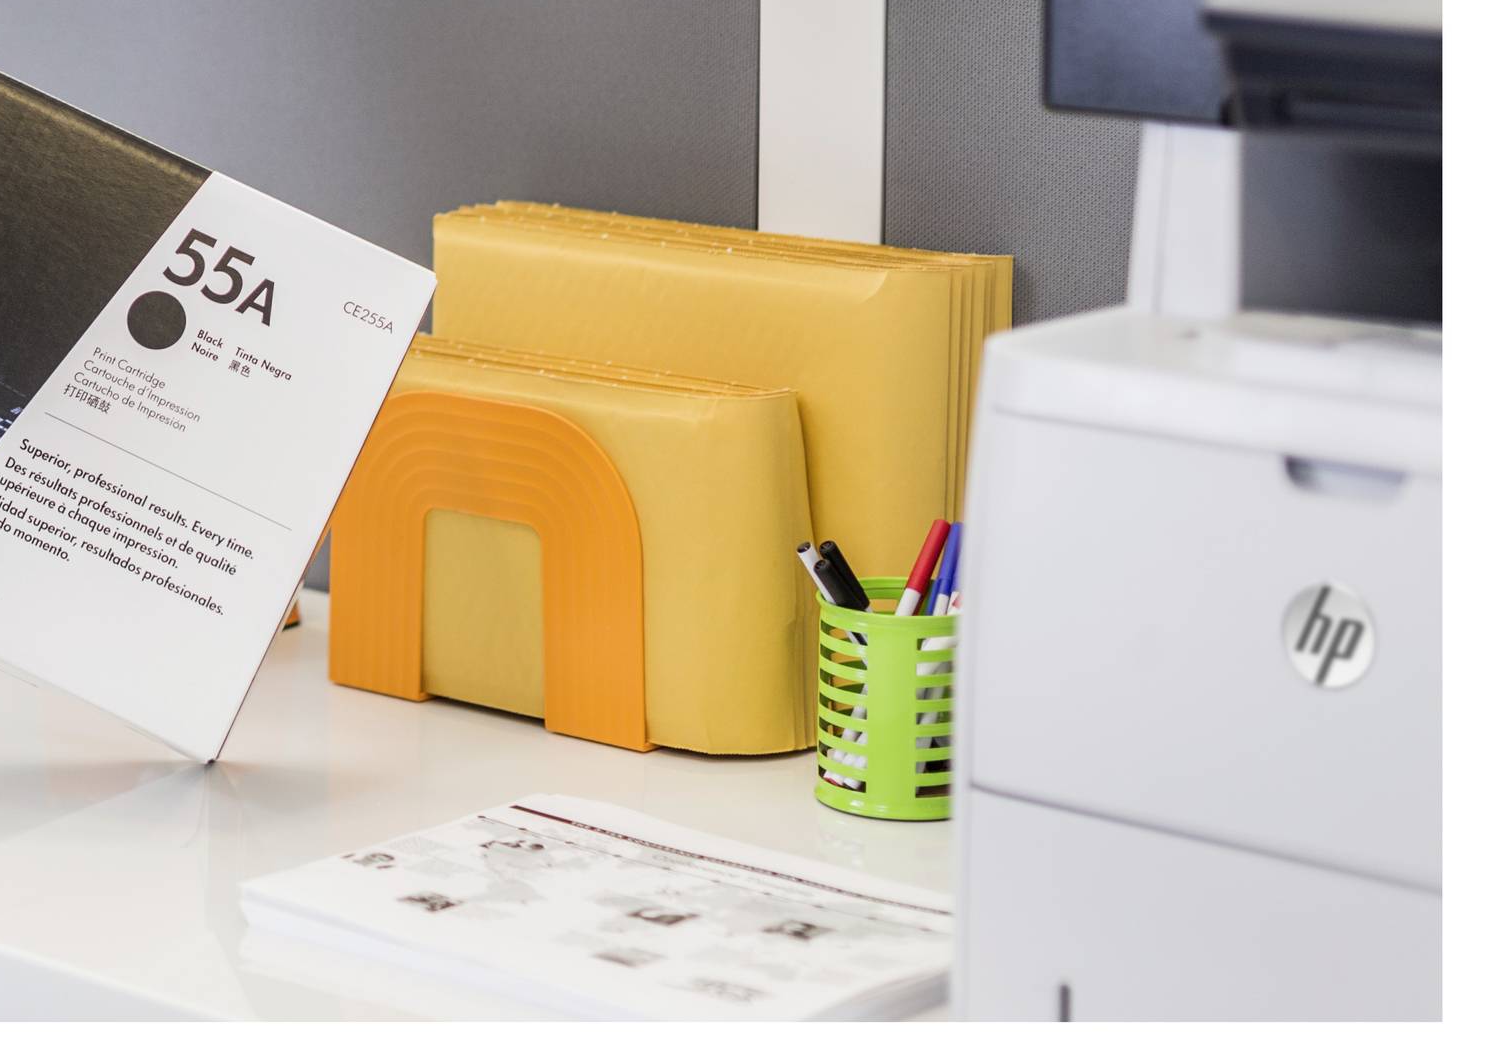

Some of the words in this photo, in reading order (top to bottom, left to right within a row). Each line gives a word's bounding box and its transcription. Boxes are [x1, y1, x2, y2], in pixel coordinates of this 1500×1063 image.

[161, 227, 275, 327] 55A
[341, 299, 394, 335] CE255A
[189, 340, 219, 362] Noire
[195, 328, 224, 349] Black
[82, 358, 136, 392] Cartouche
[91, 345, 117, 366] Print
[115, 356, 167, 390] Cartridge
[227, 358, 251, 378] 黑色
[234, 345, 259, 365] Tinta
[259, 358, 292, 381] Negra
[62, 382, 112, 415] 打印硒鼓
[72, 370, 120, 401] Cartucho
[120, 393, 136, 408] de
[135, 399, 186, 432] Impresión
[3, 455, 28, 476] Des
[27, 470, 78, 500] résultats
[76, 494, 164, 541] professionnels
[164, 535, 178, 547] et
[177, 539, 194, 556] de
[194, 550, 237, 576] qualité
[18, 437, 72, 474] Superior,
[71, 466, 149, 508] professional
[147, 502, 188, 528] results.
[190, 519, 226, 547] Every
[225, 537, 253, 560] time.
[11, 527, 70, 562] momento.
[56, 501, 67, 515] à
[66, 506, 111, 536] chaque
[111, 526, 178, 569] impression.
[25, 513, 78, 547] superior,
[79, 539, 142, 575] resultados
[140, 569, 224, 616] profesionales.
[1294, 584, 1365, 689] hp
